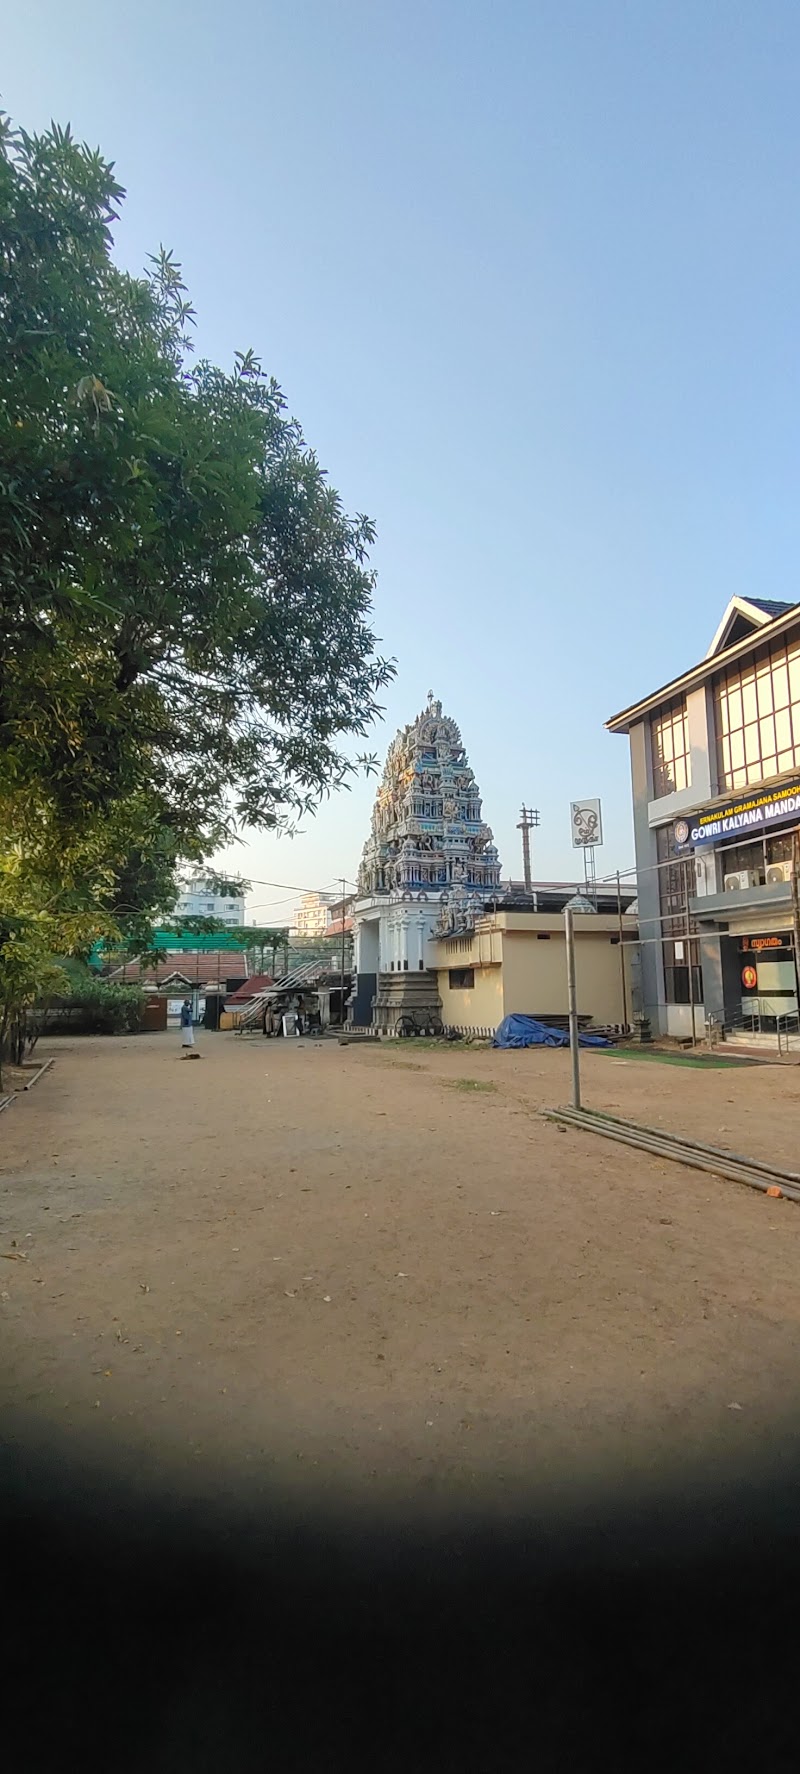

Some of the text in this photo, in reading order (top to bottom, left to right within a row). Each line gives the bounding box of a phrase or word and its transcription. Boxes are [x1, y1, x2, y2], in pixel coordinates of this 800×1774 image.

[691, 821, 721, 841] GOWRI
[722, 809, 763, 832] KALYANA
[764, 795, 800, 819] MANDA
[699, 807, 734, 825] ERNAKULAM
[734, 795, 772, 814] GRAMAJANA
